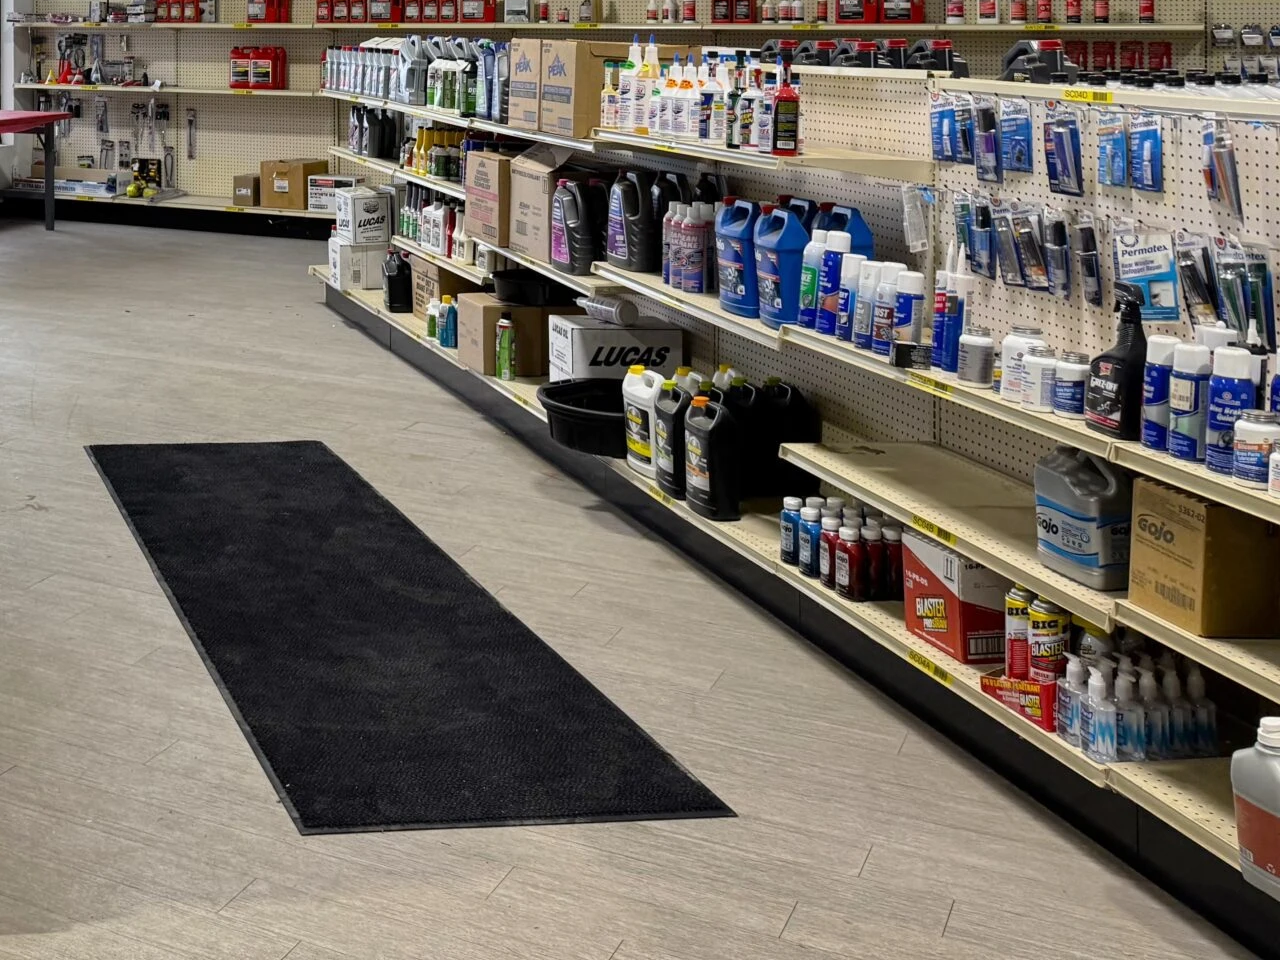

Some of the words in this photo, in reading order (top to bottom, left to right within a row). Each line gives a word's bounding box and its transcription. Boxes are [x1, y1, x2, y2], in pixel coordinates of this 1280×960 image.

[515, 58, 532, 76] PEAK
[548, 62, 567, 80] PEAK
[1064, 90, 1088, 99] SC04D
[1130, 120, 1158, 129] Permatex
[358, 215, 387, 228] LUCAS
[1121, 244, 1168, 258] Permatex
[588, 346, 671, 367] LUCAS
[1224, 407, 1242, 416] Brak
[912, 515, 935, 533] SC04B
[1032, 619, 1058, 630] BIG
[908, 651, 931, 670] SC04A
